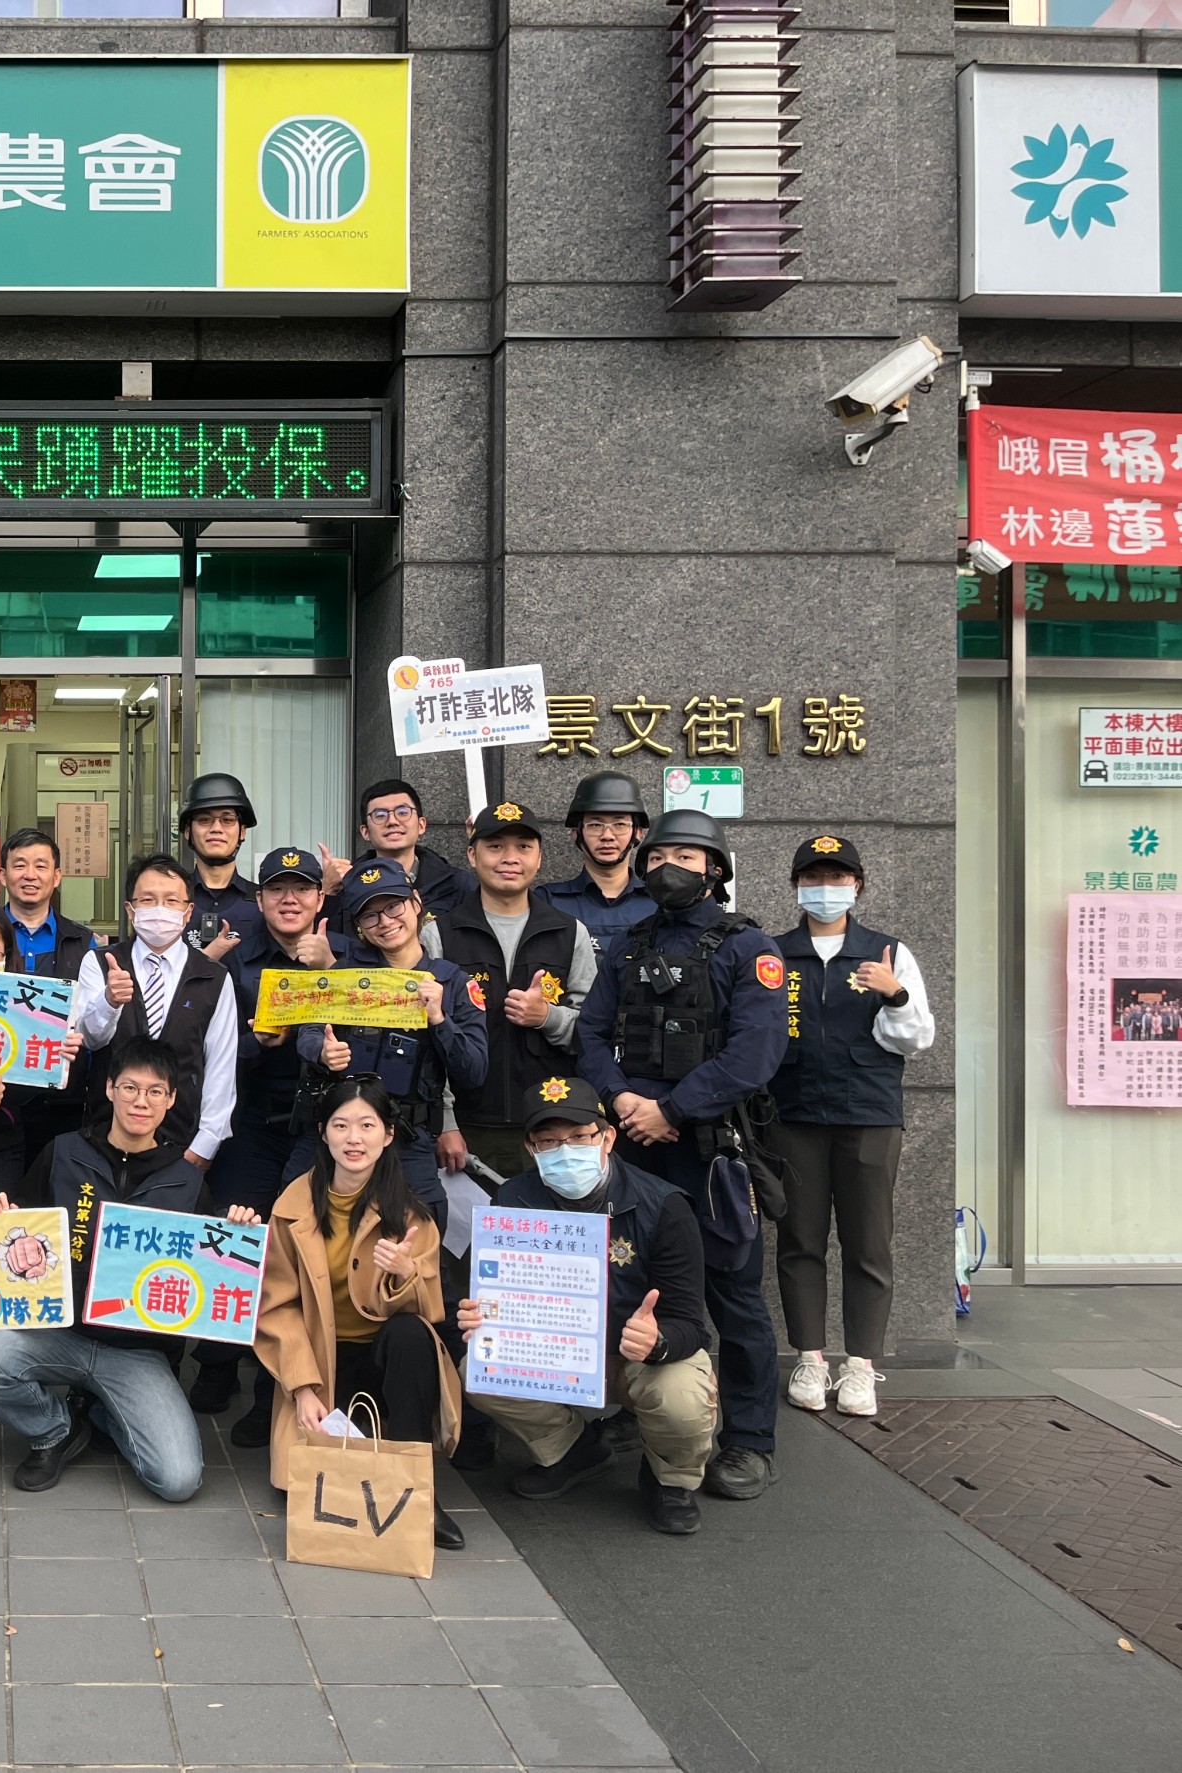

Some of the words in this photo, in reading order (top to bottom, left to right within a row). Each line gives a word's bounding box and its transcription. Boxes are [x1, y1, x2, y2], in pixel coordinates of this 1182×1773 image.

[257, 230, 300, 238] FARMERS'
[303, 230, 369, 239] ASSOCIATIONS
[998, 435, 1088, 477] 峨眉
[1000, 506, 1094, 547] 林邊
[1103, 498, 1182, 554] 蓮
[429, 677, 454, 688] 165
[415, 684, 536, 725] 打詐臺北隊
[537, 693, 866, 757] 景文街1號
[691, 769, 741, 781] 景文街
[700, 790, 710, 810] 1
[1084, 871, 1182, 891] 景美區農
[1117, 912, 1130, 968] 功德無量
[787, 970, 802, 1038] 文山第二分局
[71, 1182, 95, 1262] 文山第二分局
[314, 1471, 414, 1537] LV
